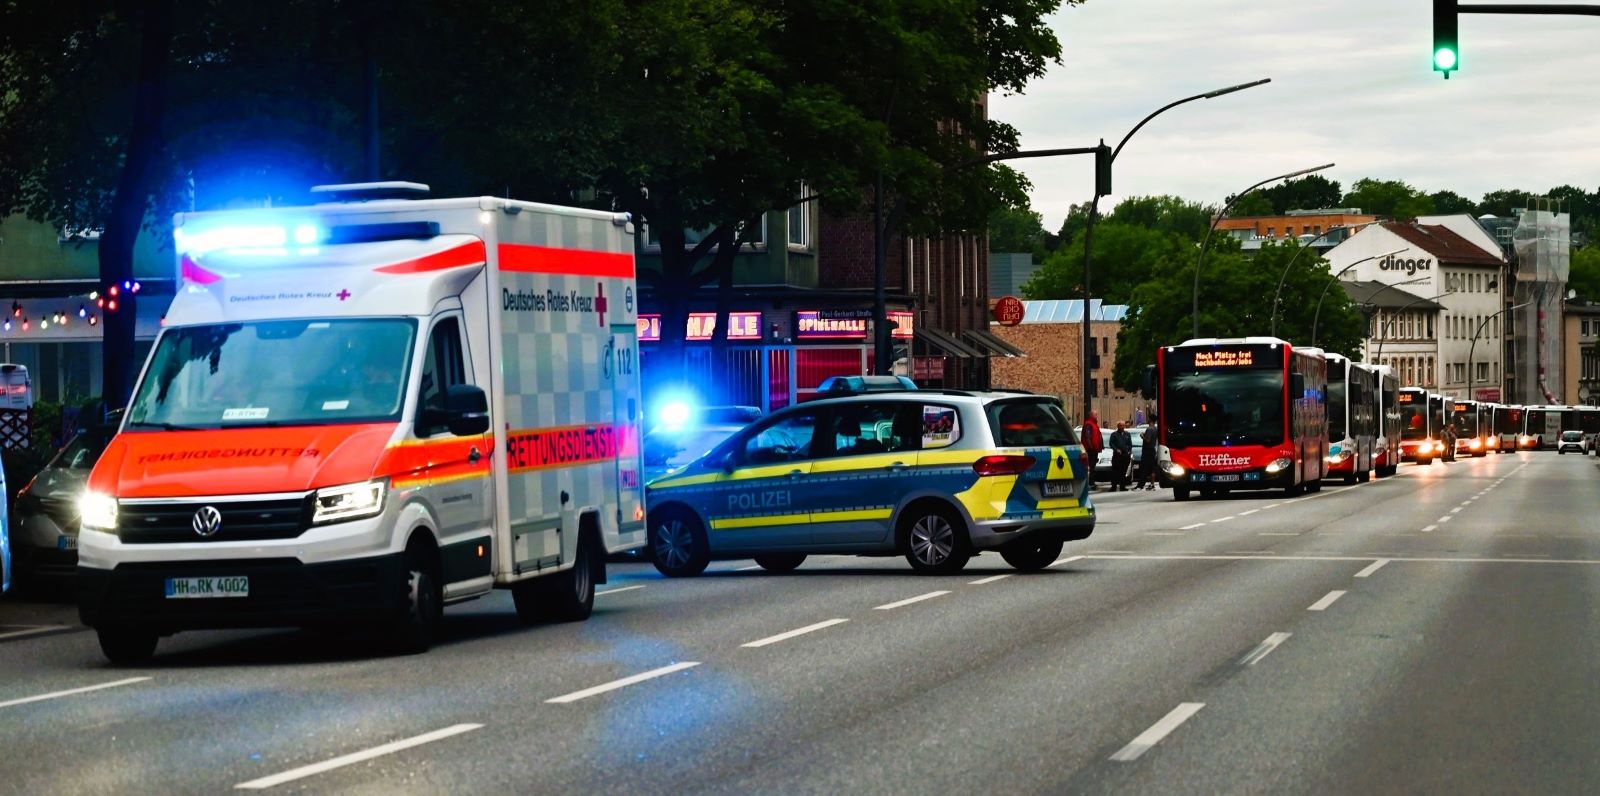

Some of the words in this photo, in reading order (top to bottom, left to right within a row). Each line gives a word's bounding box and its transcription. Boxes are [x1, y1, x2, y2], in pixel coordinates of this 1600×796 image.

[1380, 254, 1431, 276] dinger
[503, 286, 546, 312] Deutsches
[547, 288, 570, 312] Rotes
[571, 289, 593, 312] Kreuz
[618, 348, 632, 375] 112
[508, 428, 616, 467] RETTUNGSDIENST
[1199, 454, 1251, 466] Höffner
[728, 490, 791, 510] POLIZEI
[173, 579, 189, 593] HH
[197, 578, 213, 593] RK
[217, 578, 248, 593] 4002
